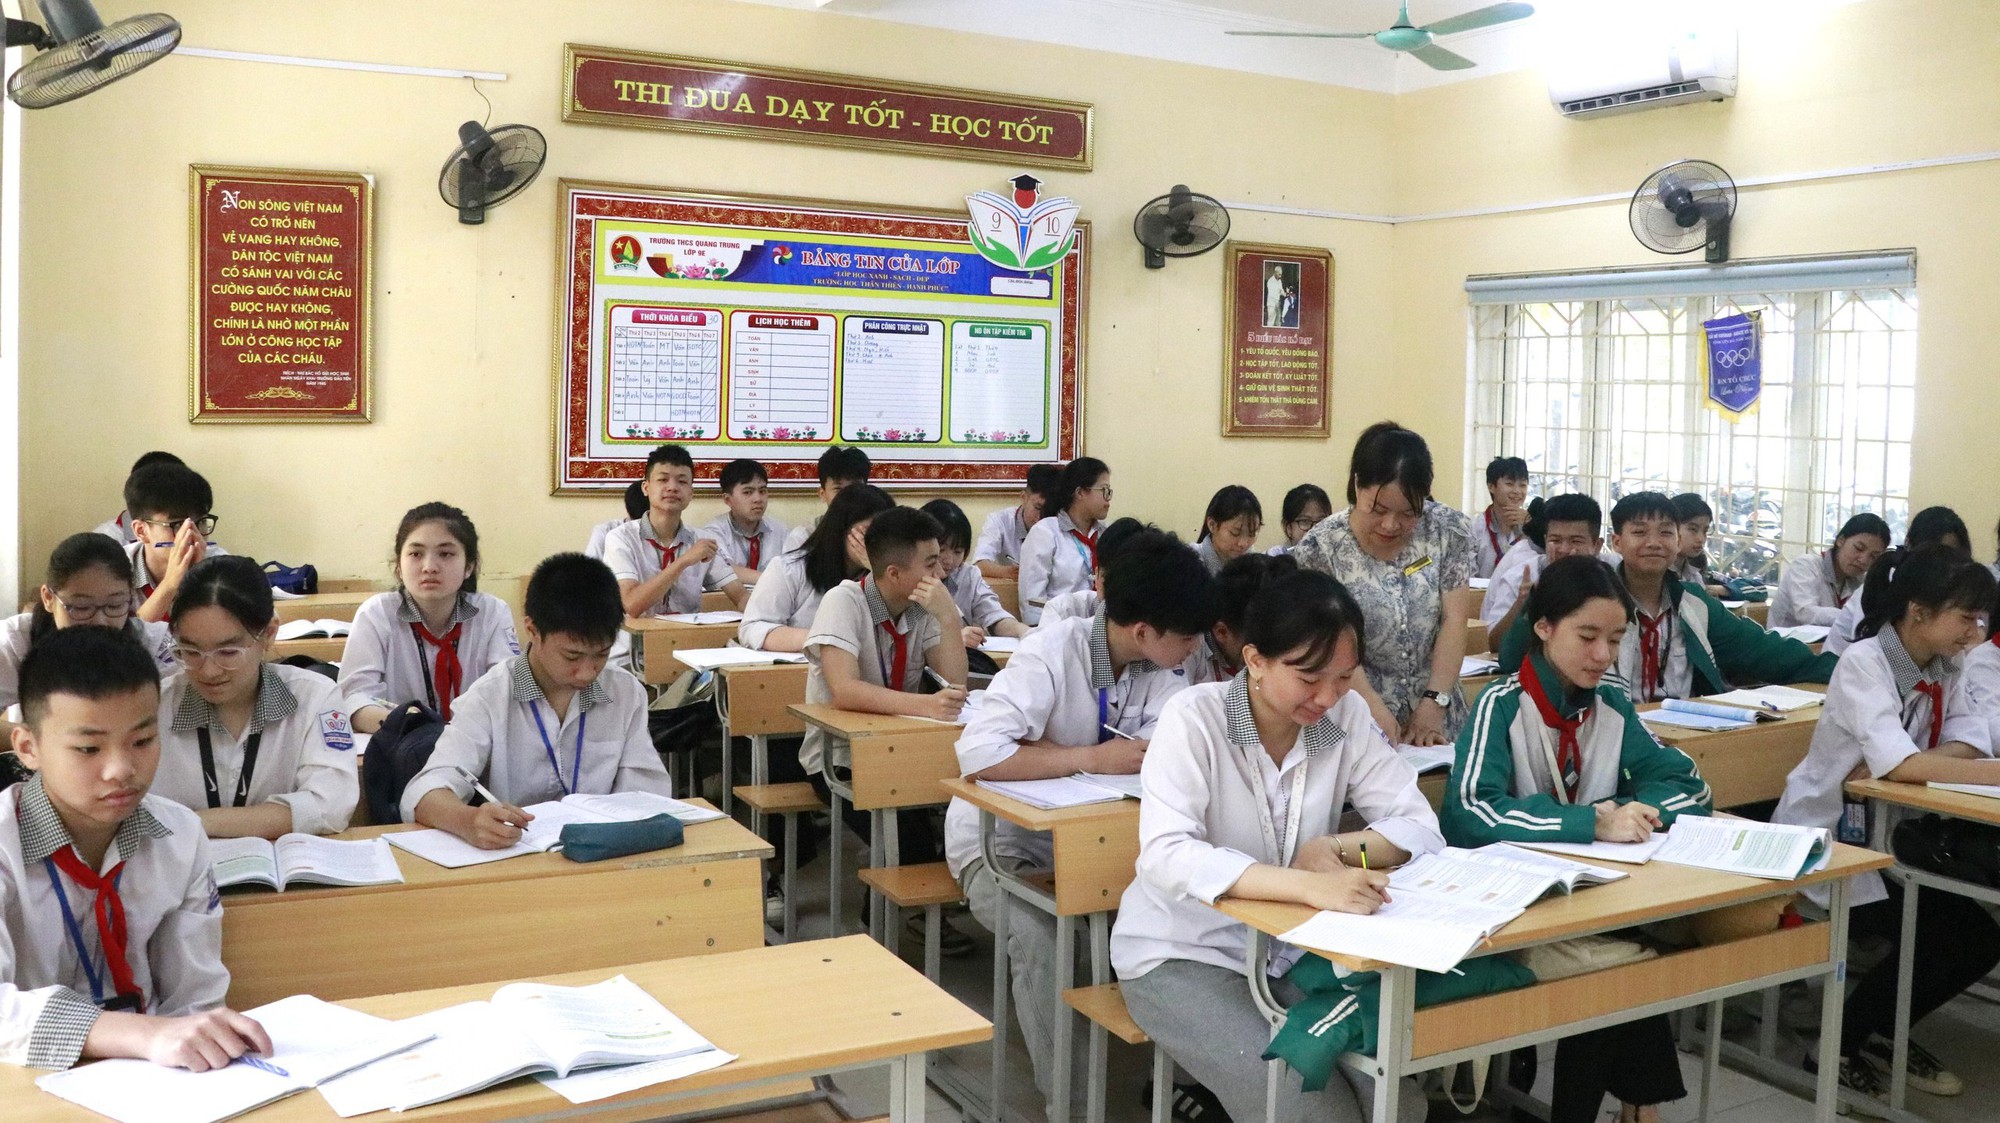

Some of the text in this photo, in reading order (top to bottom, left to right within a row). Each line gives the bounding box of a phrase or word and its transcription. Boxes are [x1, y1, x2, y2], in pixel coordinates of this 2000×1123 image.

[614, 80, 673, 105] THI
[684, 87, 755, 113] ĐUA
[766, 95, 835, 124] DẠY
[844, 99, 904, 129] TỐT
[929, 114, 990, 140] HỌC
[998, 116, 1053, 144] TỐT
[221, 190, 342, 213] NON SÔNG VIỆT NAM
[251, 216, 315, 229] CÓ TRỞ NÊN
[992, 212, 1001, 229] 9
[1046, 217, 1060, 233] 10
[223, 231, 342, 248] VẺ VANG HAY KHÔNG,
[232, 249, 332, 265] DÂN TỘC VIỆT NAM
[801, 248, 960, 274] BẢNG TIN CỦA LỚP
[222, 266, 342, 281] CÓ SÁNH VAI VỚI CÁC
[212, 281, 351, 297] CƯỜNG QUỐC NĂM CHÂU
[231, 302, 333, 315] ĐƯỢC HAY KHÔNG,
[214, 317, 349, 333] CHÍNH LÀ NHỜ MỘT PHẦN
[640, 312, 698, 323] THỜI KHÓA BIỂU
[755, 318, 811, 327] LỊCH HỌC THÊM
[222, 333, 342, 350] LỚN Ở CÔNG HỌC TẬP
[238, 350, 326, 364] CỦA CÁC CHÁU.
